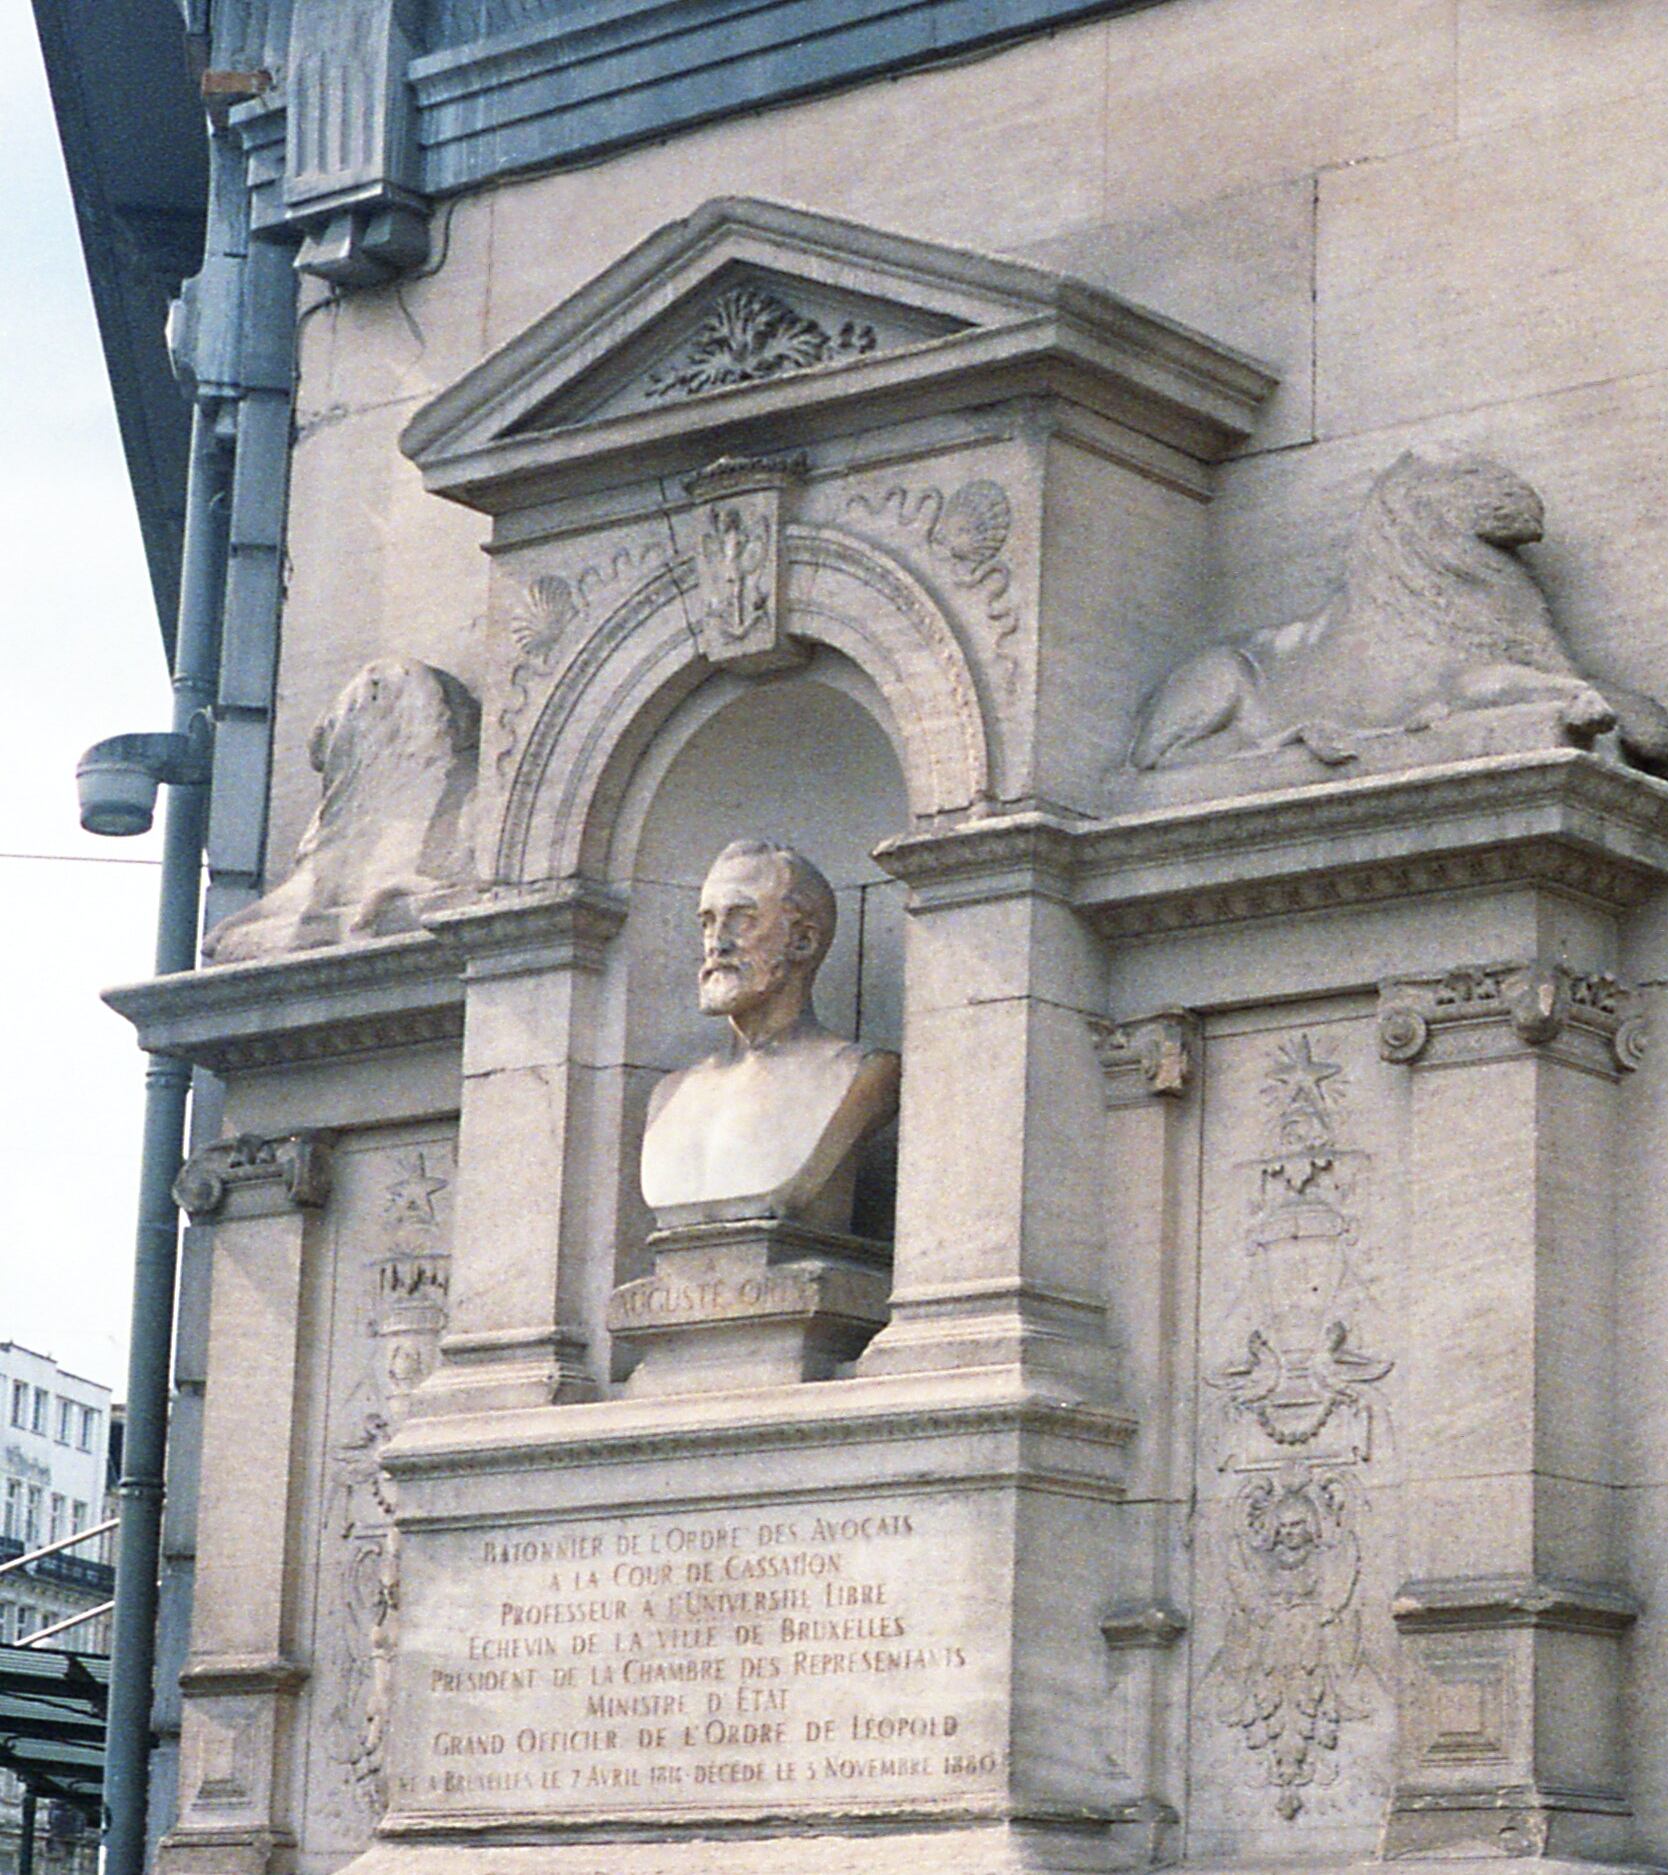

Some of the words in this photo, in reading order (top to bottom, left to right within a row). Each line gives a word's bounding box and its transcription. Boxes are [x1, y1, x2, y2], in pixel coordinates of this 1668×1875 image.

[616, 1535, 641, 1555] DE
[758, 1523, 797, 1546] DES
[811, 1515, 914, 1541] AVOCATS
[574, 1571, 599, 1590] LA
[613, 1562, 673, 1587] COUR
[687, 1562, 713, 1584] DE
[725, 1551, 841, 1580] CASSATION
[501, 1600, 627, 1626] PROFESSEUR
[826, 1581, 887, 1609] LIBRE
[572, 1633, 599, 1655] DE
[615, 1632, 643, 1652] LA
[656, 1626, 718, 1649] VILLE
[736, 1625, 764, 1646] DE
[781, 1616, 906, 1643] BRUXELLES
[553, 1667, 577, 1688] DE
[591, 1665, 613, 1686] LA
[623, 1658, 726, 1684] CHAMBRE
[740, 1656, 781, 1679] DES
[586, 1694, 685, 1718] MINISTRE
[433, 1731, 506, 1757] GRAND
[517, 1727, 617, 1752] OFFICIER
[638, 1727, 668, 1749] DE
[806, 1718, 836, 1744] DE
[541, 1770, 562, 1789] LE
[571, 1769, 581, 1788] 7
[587, 1765, 641, 1788] AVRIL
[776, 1762, 797, 1781] LE
[824, 1756, 934, 1779] NOVEMBRE
